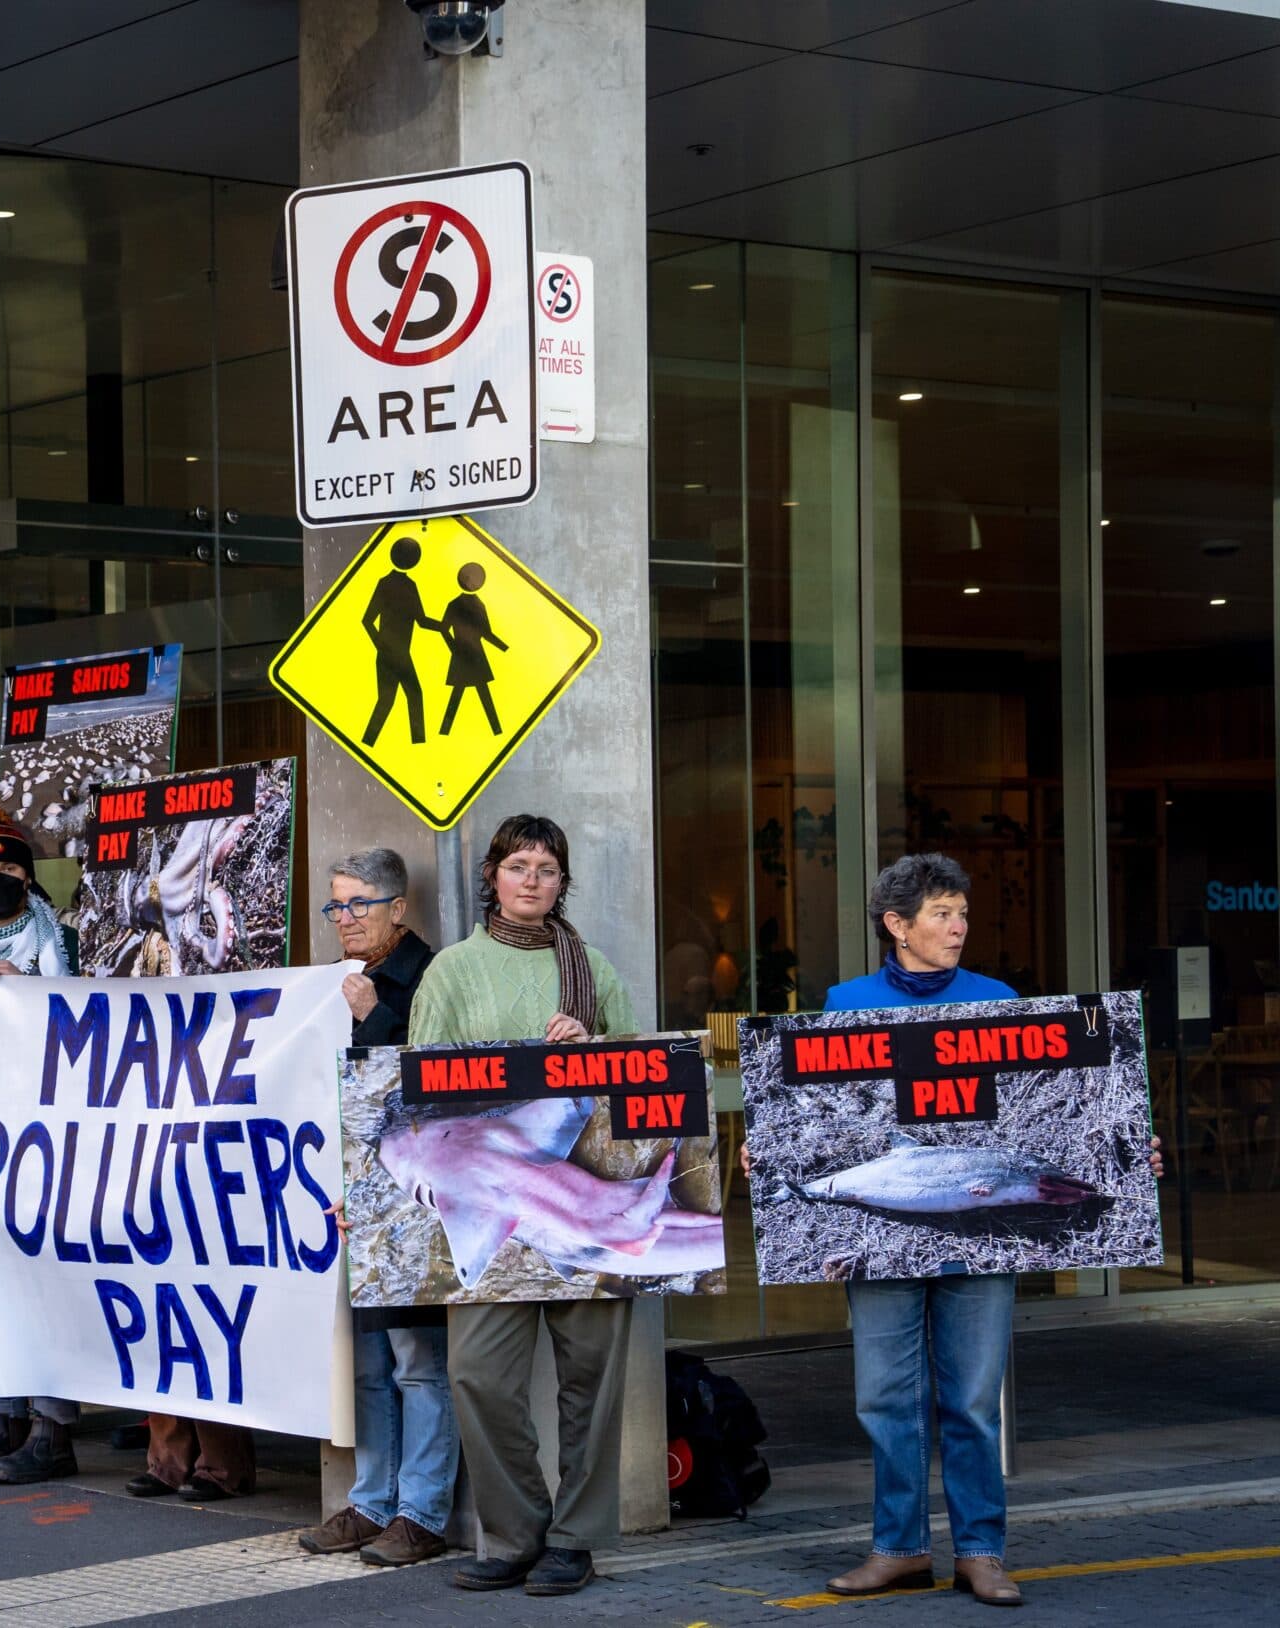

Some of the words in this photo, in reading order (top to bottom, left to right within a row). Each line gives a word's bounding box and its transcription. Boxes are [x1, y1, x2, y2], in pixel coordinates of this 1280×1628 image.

[538, 338, 554, 354] AT
[561, 340, 585, 356] ALL
[539, 357, 583, 375] TIMES
[327, 379, 508, 444] AREA
[314, 472, 395, 502] EXCEPT
[410, 468, 436, 493] AS
[449, 457, 522, 488] SIGNED
[14, 671, 54, 701] MAKE
[72, 662, 131, 695] SANTOS
[11, 708, 38, 736] PAY
[99, 790, 146, 824] MAKE
[164, 778, 234, 816] SANTOS
[97, 831, 131, 863] PAY
[40, 988, 282, 1109] MAKE
[794, 1032, 893, 1074] MAKE
[934, 1023, 1069, 1065] SANTOS
[420, 1056, 508, 1093] MAKE
[544, 1048, 669, 1088] SANTOS
[625, 1093, 686, 1130] PAY
[912, 1077, 980, 1117] PAY
[94, 1279, 258, 1405] PAY
